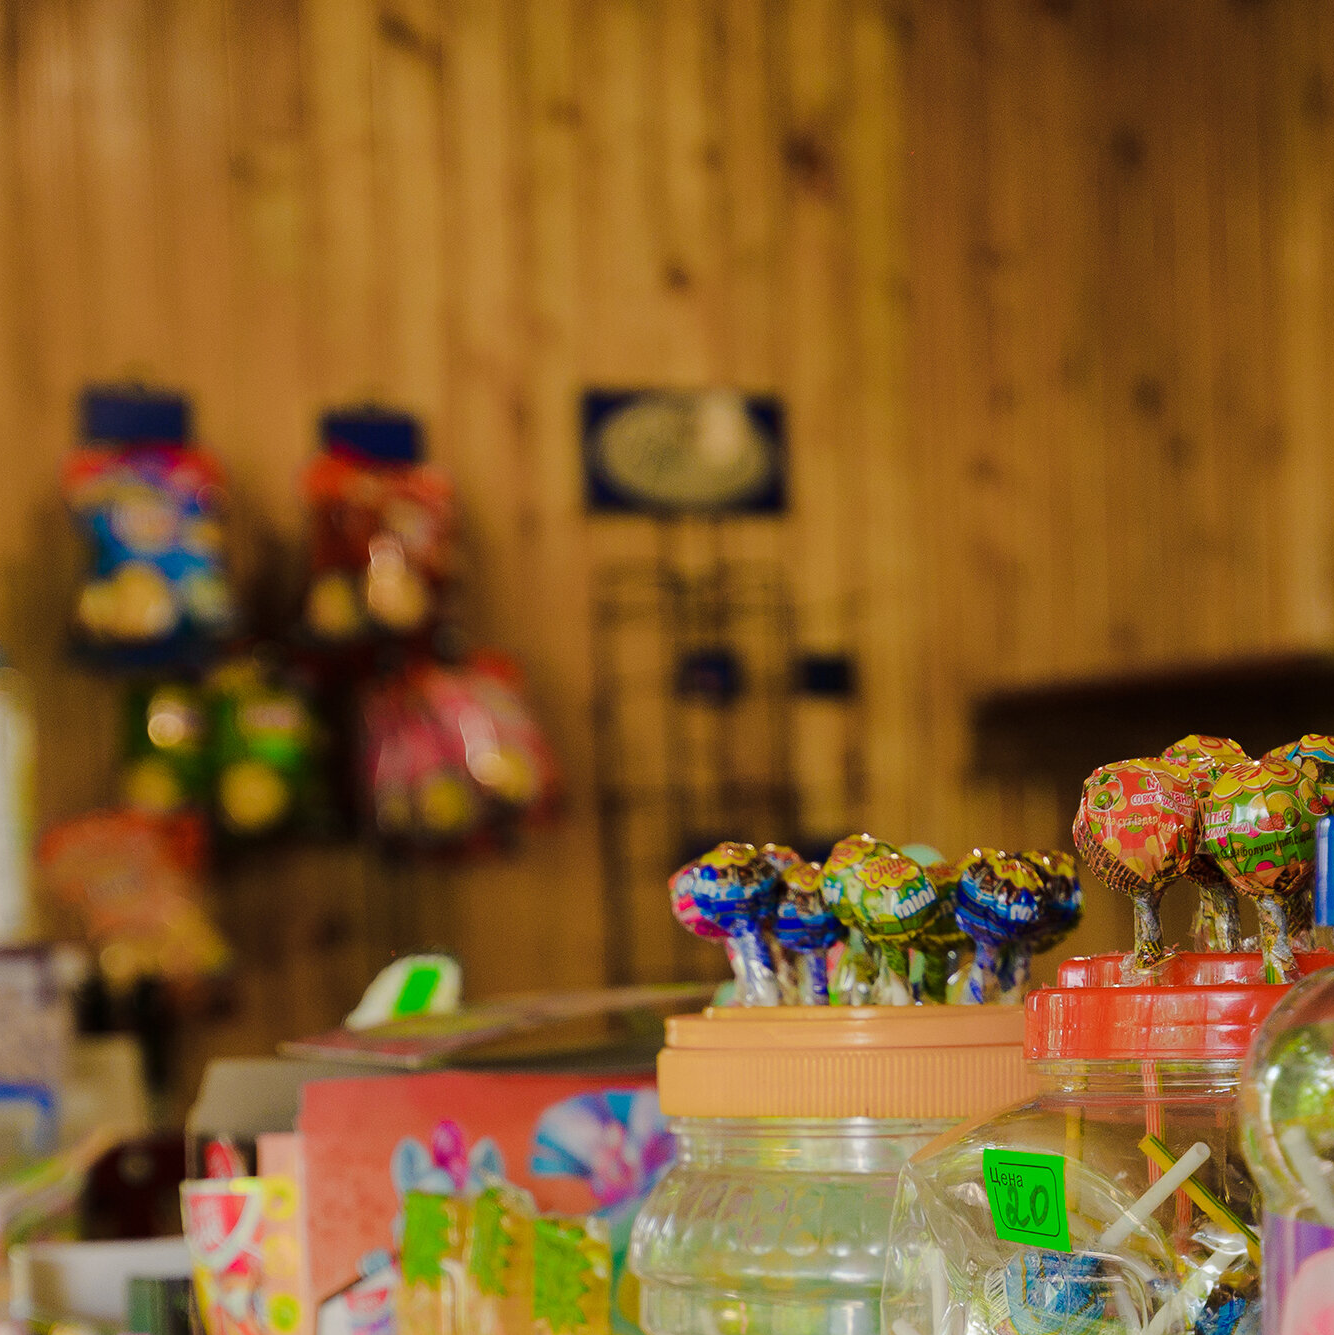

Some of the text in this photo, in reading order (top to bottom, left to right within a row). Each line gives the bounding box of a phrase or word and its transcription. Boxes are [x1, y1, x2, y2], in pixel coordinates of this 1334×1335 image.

[894, 877, 937, 918] mini
[989, 1167, 1024, 1188] Цена
[1006, 1184, 1049, 1227] 20
